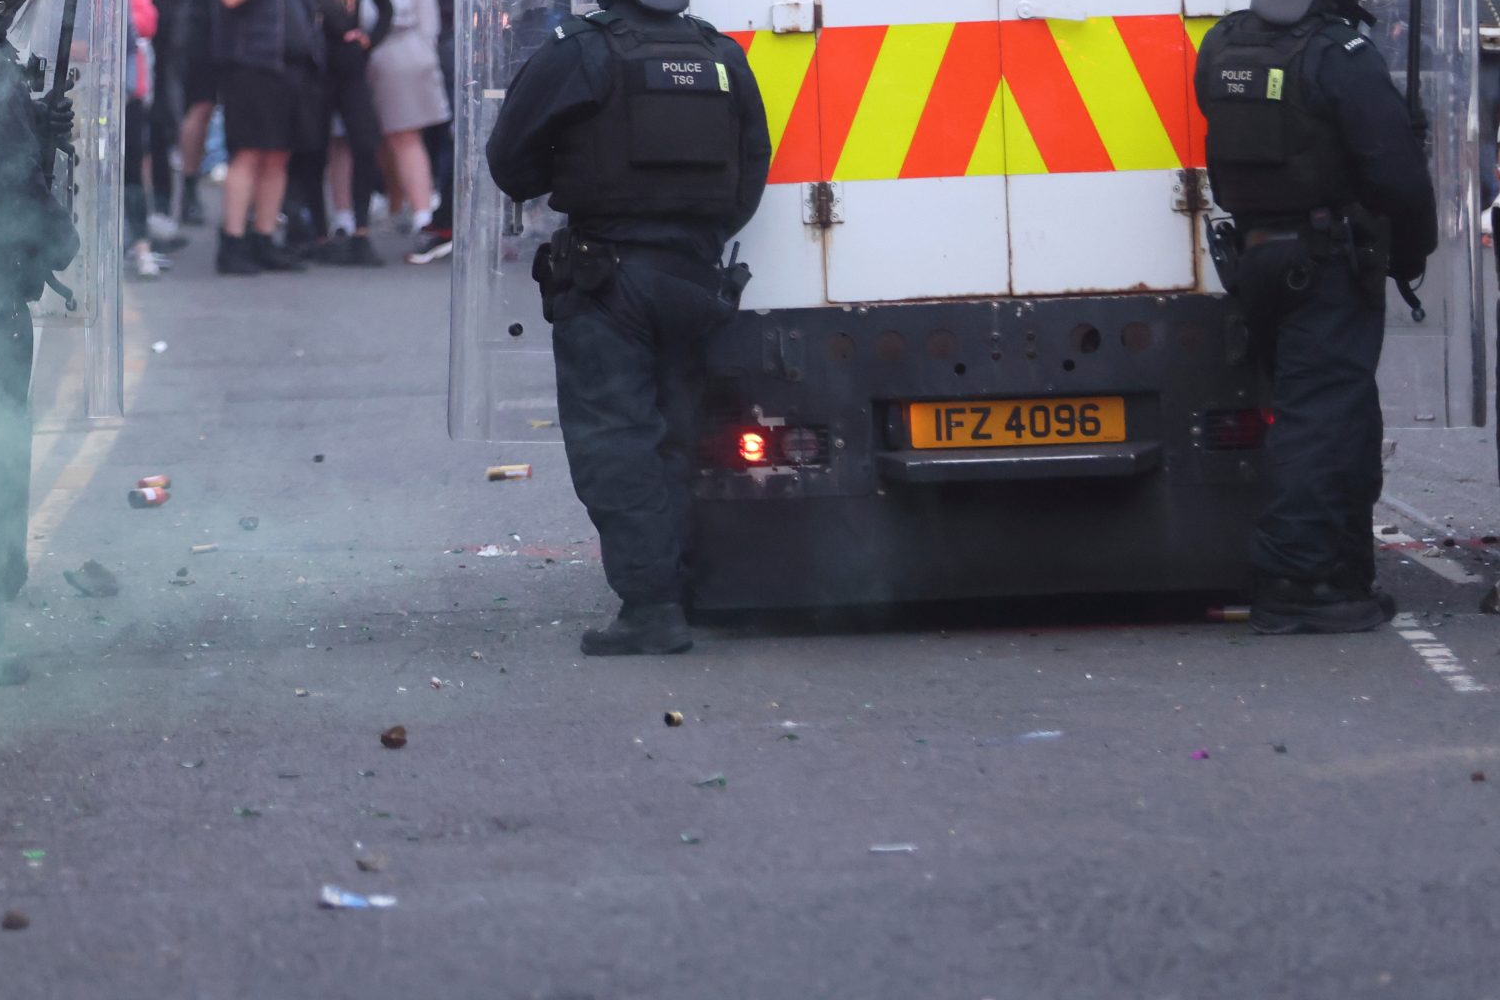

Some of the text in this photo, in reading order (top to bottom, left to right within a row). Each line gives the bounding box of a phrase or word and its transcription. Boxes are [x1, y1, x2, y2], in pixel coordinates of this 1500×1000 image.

[662, 62, 702, 73] POLICE
[672, 75, 695, 85] TSG
[1221, 69, 1253, 81] POLICE
[1227, 82, 1245, 94] TSG
[934, 402, 1101, 441] IFZ 4096
